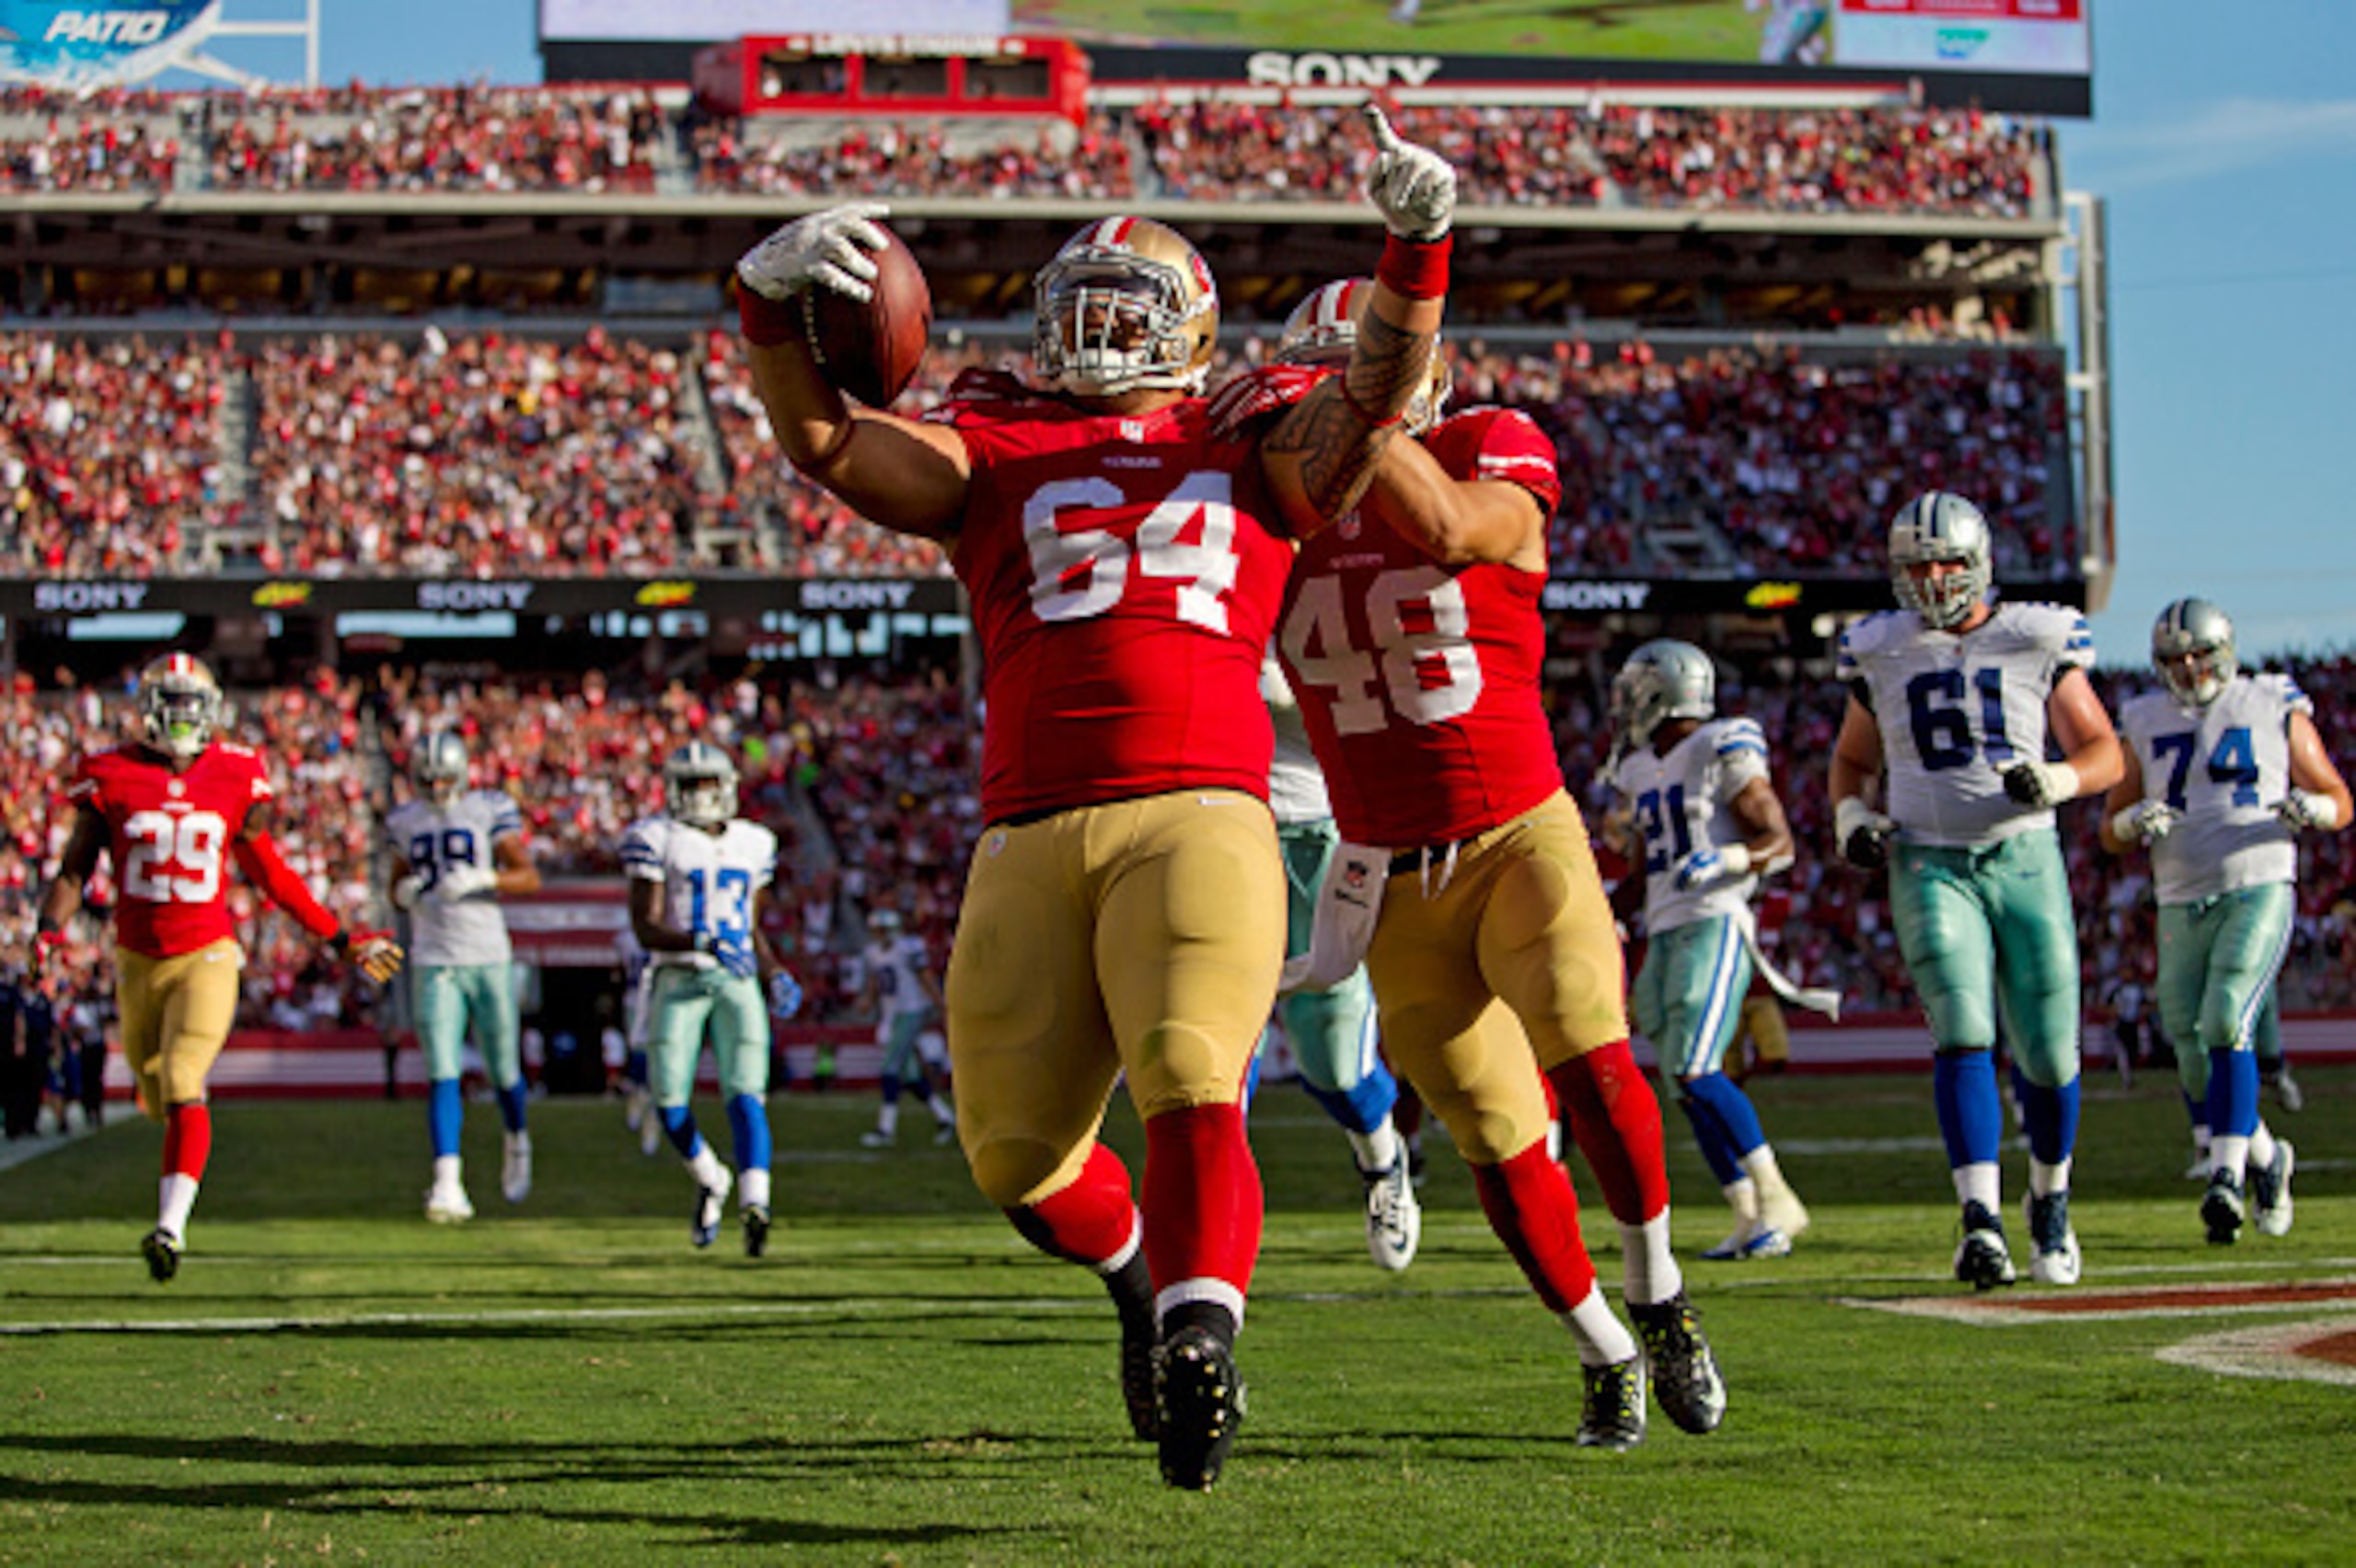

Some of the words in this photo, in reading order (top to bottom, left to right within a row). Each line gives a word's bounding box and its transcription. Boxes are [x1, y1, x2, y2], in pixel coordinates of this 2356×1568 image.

[43, 11, 169, 43] PATIO
[1246, 51, 1442, 87] SONY
[1022, 470, 1240, 637] 64
[34, 582, 147, 609] SONY
[417, 582, 534, 609] SONY
[800, 582, 914, 609] SONY
[1542, 582, 1650, 609] SONY
[1280, 566, 1484, 737] 48
[1907, 669, 2015, 771] 61
[2152, 727, 2258, 813] 74
[123, 811, 227, 903] 29
[1637, 784, 1691, 876] 21
[688, 868, 751, 946] 13
